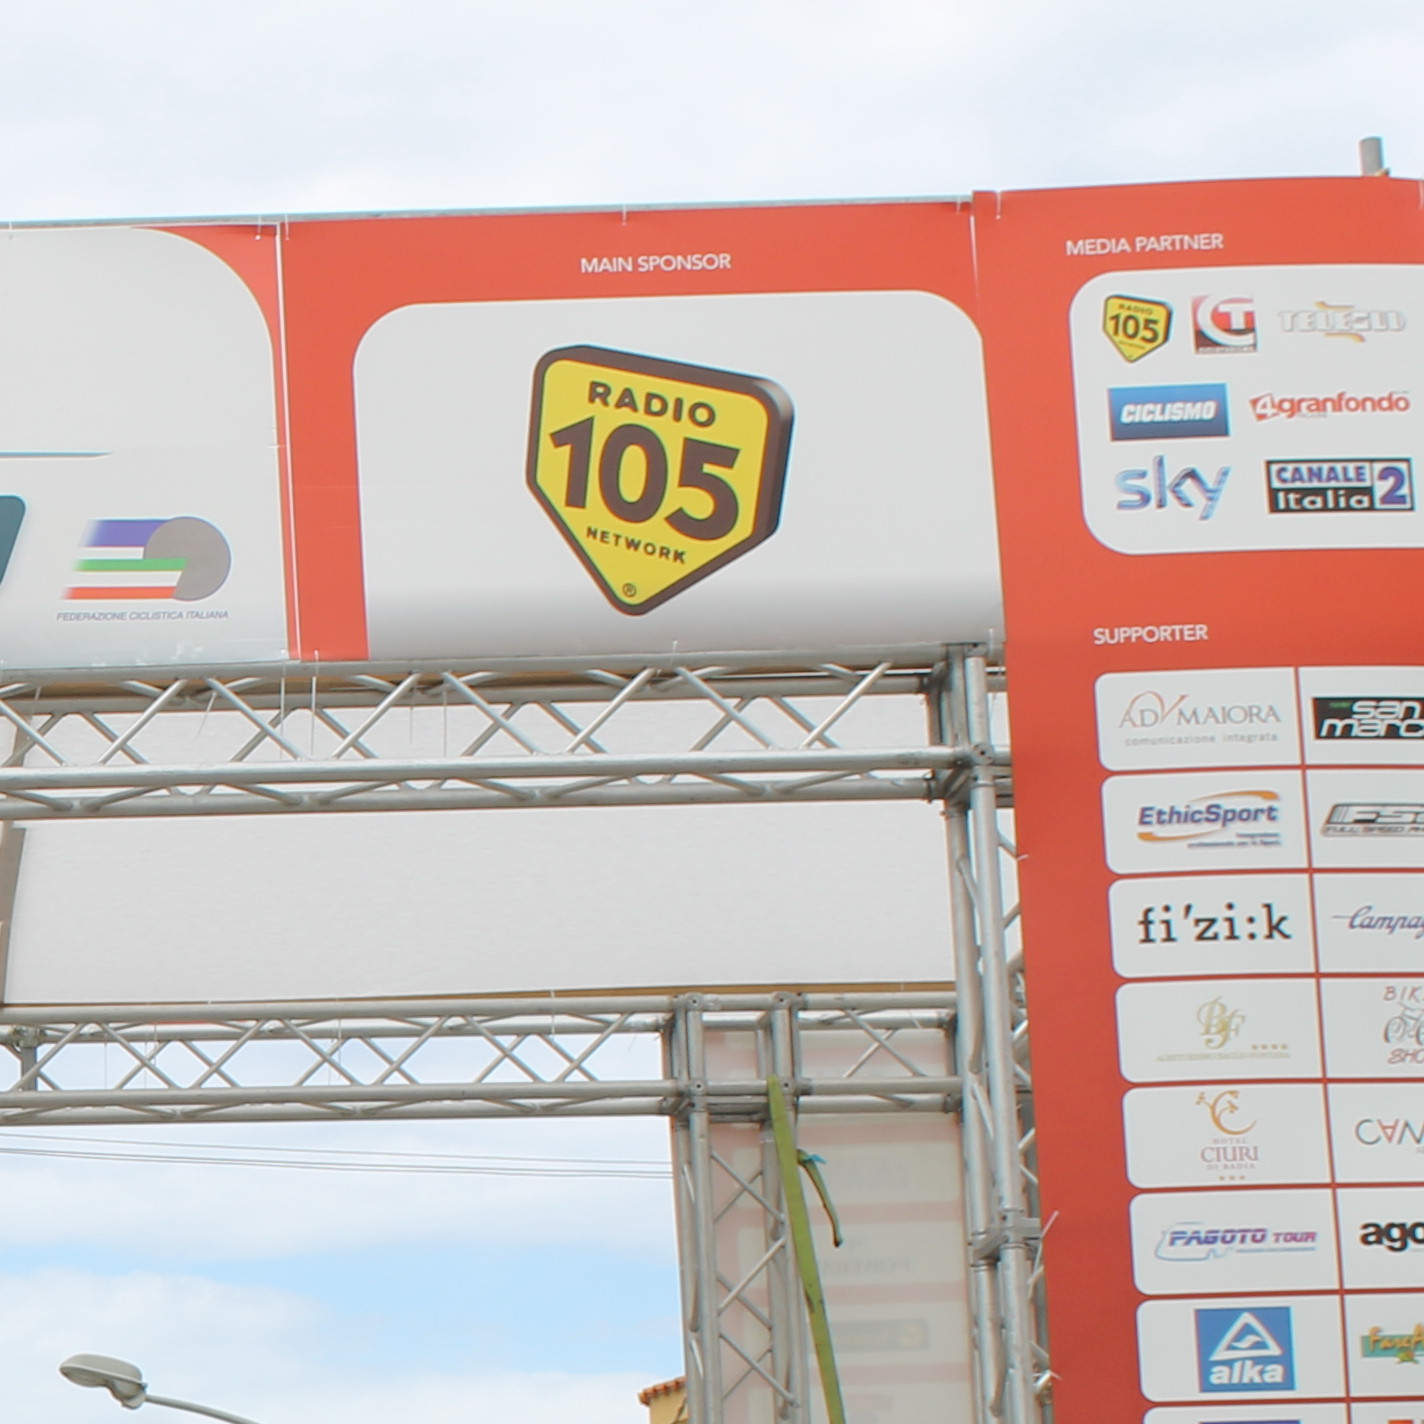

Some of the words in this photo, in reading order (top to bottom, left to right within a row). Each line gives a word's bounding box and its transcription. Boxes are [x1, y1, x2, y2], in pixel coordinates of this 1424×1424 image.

[1066, 238, 1131, 256] MEDIA
[1136, 233, 1224, 252] PARTNER
[580, 257, 633, 273] MAIN
[637, 254, 732, 271] SPONSOR
[1110, 313, 1160, 344] 105
[588, 380, 716, 428] RADIO
[1120, 400, 1218, 423] CICLISMO
[549, 415, 742, 541] 105
[1115, 455, 1232, 521] sky
[1275, 465, 1367, 484] CANALE
[1376, 466, 1408, 506] 2
[1276, 489, 1370, 510] Italia
[586, 526, 687, 564] NETWORK
[56, 611, 128, 622] FEDERAZIONE
[129, 610, 184, 621] CICLISTICA
[186, 609, 230, 620] ITALIANA
[1093, 624, 1209, 645] SUPPORTER
[1176, 704, 1282, 726] MAIORA
[1351, 700, 1421, 719] san
[1319, 718, 1424, 738] marc
[1138, 803, 1279, 828] EthicSport
[1383, 985, 1424, 1002] BIK
[1200, 1145, 1259, 1163] CIURI
[1168, 1228, 1268, 1248] PAGOTO
[1272, 1231, 1318, 1244] TOUR
[1209, 1360, 1285, 1385] alka
